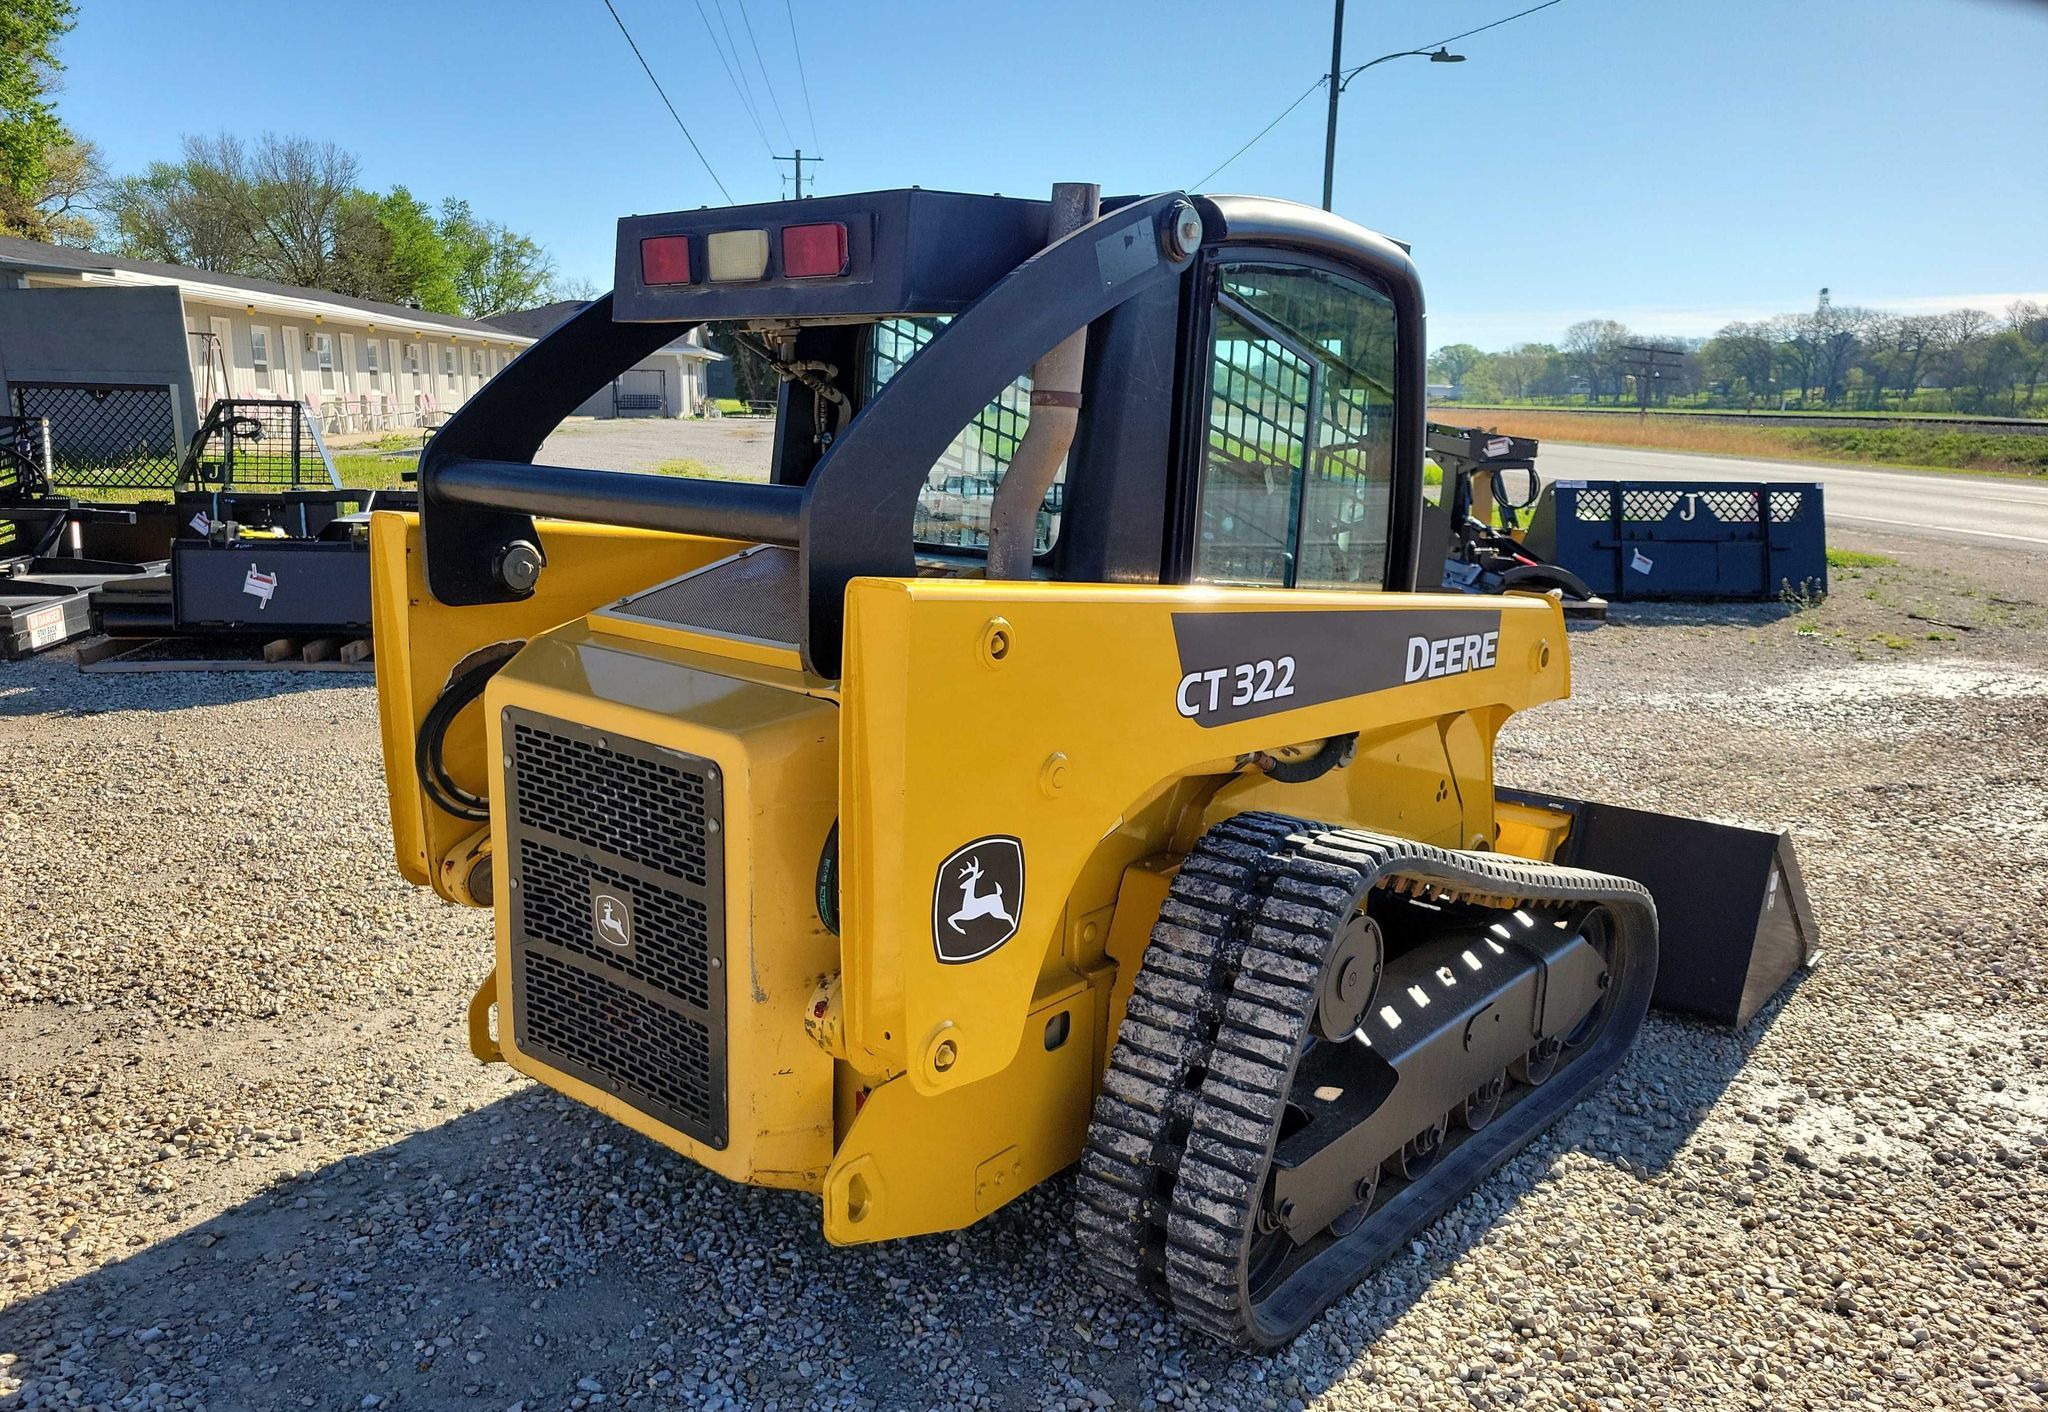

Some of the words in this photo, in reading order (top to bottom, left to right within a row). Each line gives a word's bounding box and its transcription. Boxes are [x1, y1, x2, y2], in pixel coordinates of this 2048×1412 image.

[209, 464, 221, 479] J
[1680, 493, 1699, 520] J
[1404, 631, 1499, 683] DEERE
[1176, 668, 1228, 716] CT
[1232, 656, 1296, 706] 322
